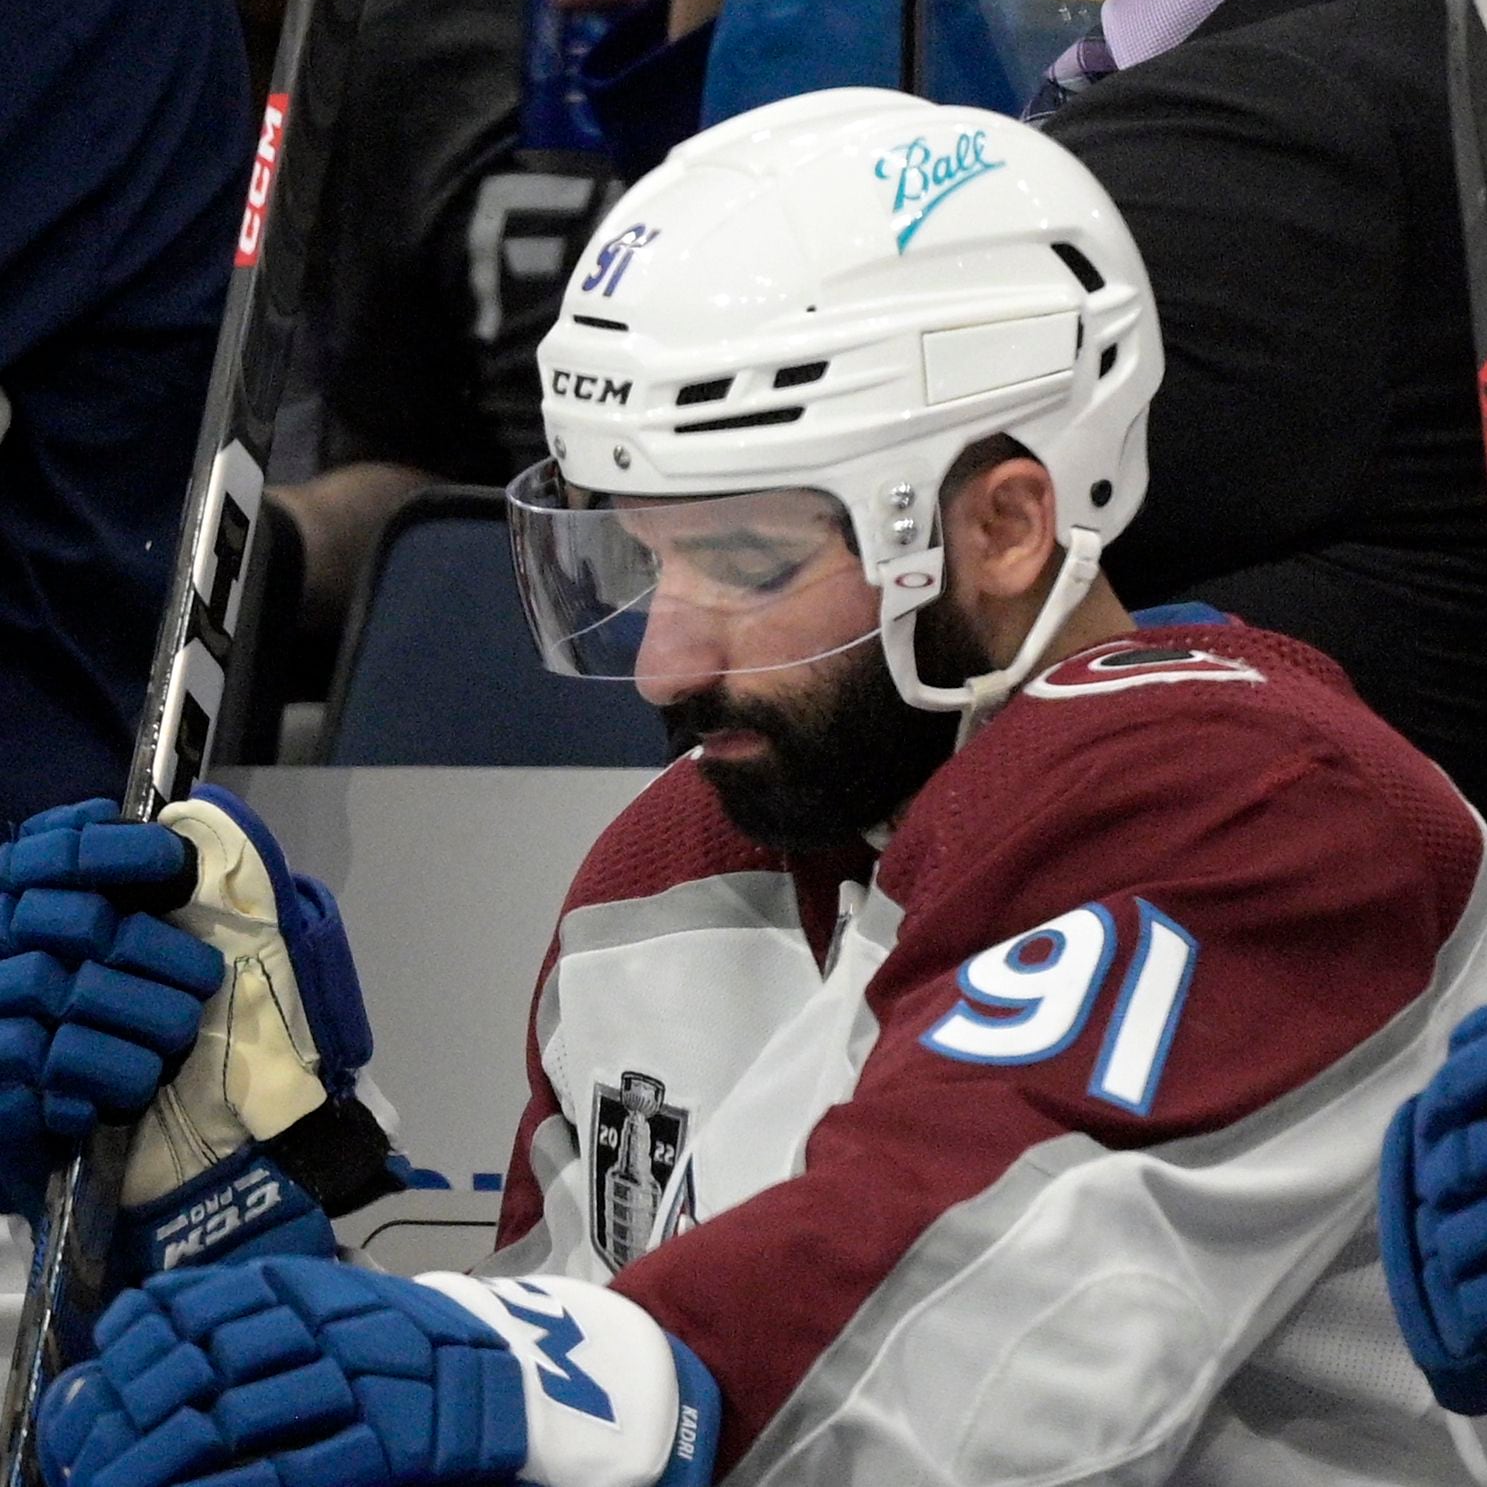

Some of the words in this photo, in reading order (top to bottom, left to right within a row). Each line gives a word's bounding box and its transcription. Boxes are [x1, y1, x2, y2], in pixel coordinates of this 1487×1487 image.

[238, 104, 283, 256] CCM
[874, 130, 1006, 234] Ball
[581, 223, 661, 298] 91
[551, 369, 633, 406] CCM
[917, 895, 1200, 1117] 91
[600, 1124, 619, 1150] 20
[653, 1141, 675, 1166] 22
[164, 1180, 282, 1271] CCM
[676, 1404, 698, 1462] KADRI
